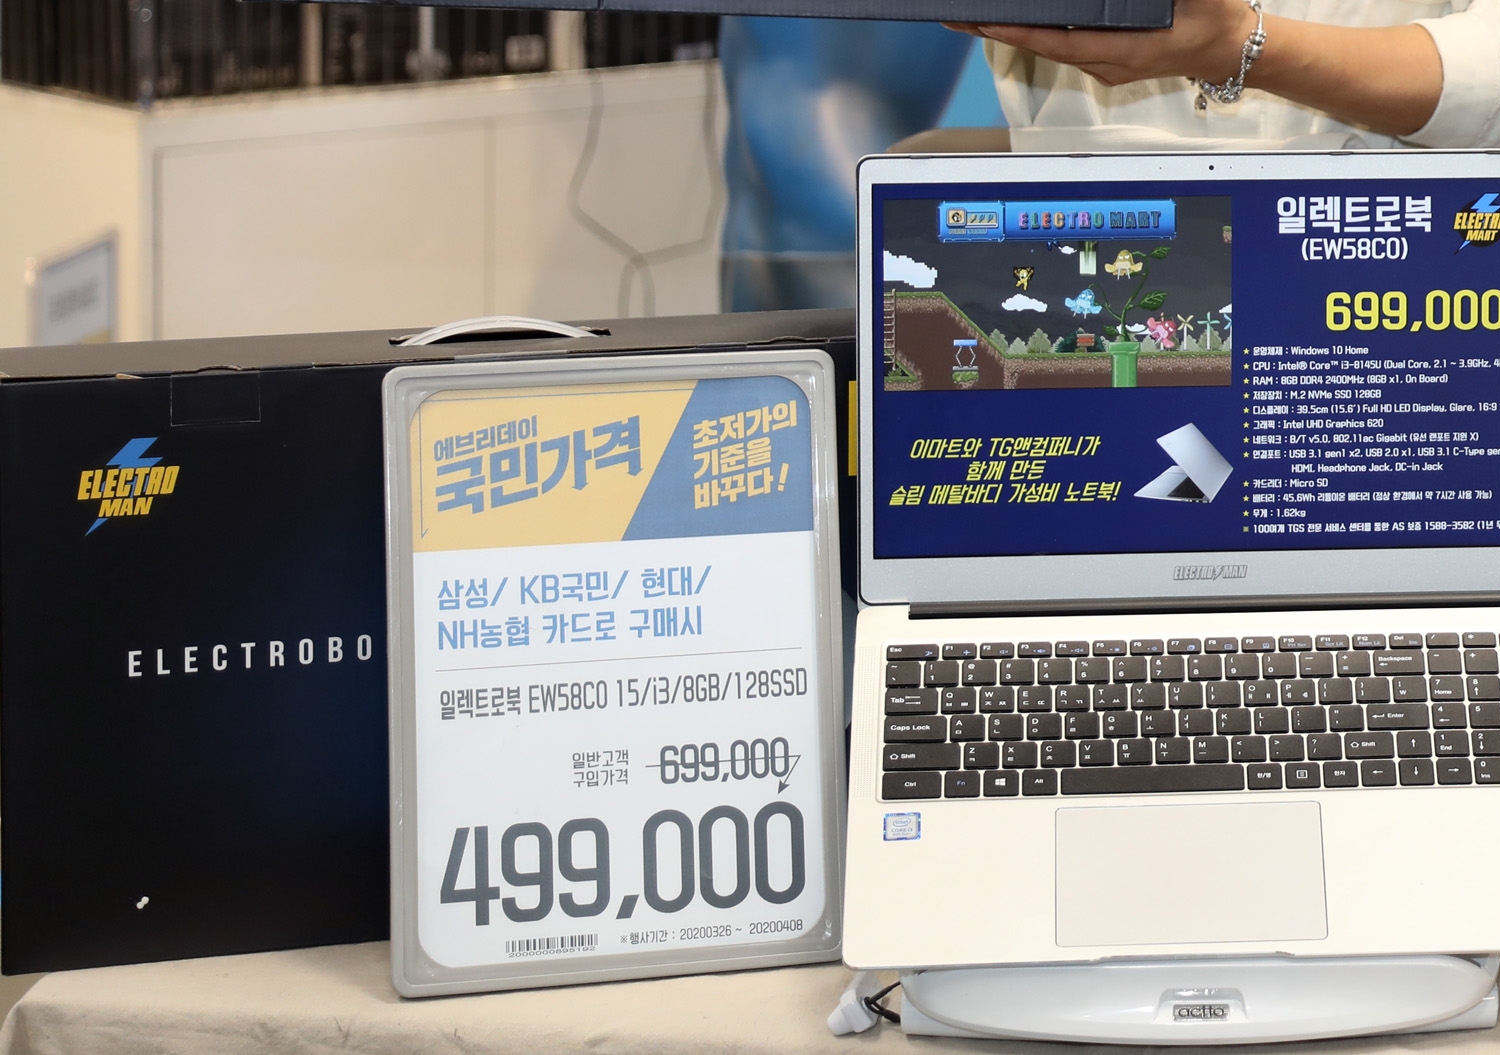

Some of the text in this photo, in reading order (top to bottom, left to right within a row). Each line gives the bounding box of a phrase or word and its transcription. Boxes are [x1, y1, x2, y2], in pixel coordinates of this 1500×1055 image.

[1019, 211, 1162, 229] ELECTRO MART
[1277, 195, 1433, 234] 일렉트로북
[1466, 229, 1498, 242] MART
[1253, 346, 1369, 356] 운영체제 Windows 10 Home
[1253, 362, 1270, 370] CPU
[1341, 360, 1382, 369] i3-8145U
[1383, 360, 1406, 369] (Dual
[1433, 359, 1447, 368] 2.1
[1253, 376, 1273, 385] RAM
[1281, 376, 1298, 384] 8GB
[1300, 376, 1323, 384] DDR4
[1325, 375, 1365, 384] 2400MHz
[1366, 375, 1387, 383] (8GB
[1405, 374, 1417, 383] On
[1419, 374, 1449, 383] Board)
[1253, 389, 1382, 400] 저장장치 M.2 NVMe SSD 128GB
[1253, 405, 1289, 414] 디스플레이
[1297, 405, 1329, 414] 39.5cm
[1363, 404, 1378, 413] Full
[1380, 404, 1392, 412] HD
[1394, 404, 1411, 412] LED
[1478, 403, 1497, 411] 16:9
[693, 399, 798, 447] 초저가의
[1253, 419, 1384, 429] 그래픽 Intel UHD Graphics 620
[434, 415, 538, 461] 에브리데이
[910, 435, 1101, 459] 이마트와 TG앤컴퍼니가
[1253, 435, 1282, 444] 네트워크
[1290, 435, 1306, 443] B/T
[1333, 434, 1374, 443] 802.11ac
[1376, 433, 1407, 442] Gigabit
[1409, 433, 1427, 442] (유선
[1452, 432, 1468, 441] 지원
[1469, 432, 1479, 441] X)
[435, 415, 644, 515] 국민가격
[693, 436, 772, 480] 기준을
[1317, 464, 1367, 472] Headphone
[1395, 462, 1420, 471] DC-in
[1421, 462, 1443, 470] Jack
[966, 459, 1046, 481] 함께 만든
[77, 465, 180, 501] ELECTRO
[694, 463, 789, 510] 바꾸다!
[1253, 478, 1329, 488] 카드리더 Micro SD
[889, 481, 1122, 507] 슬림 메탈바디 가성비 노트북!
[98, 497, 153, 518] MAN
[1253, 508, 1306, 517] 무게 1.62kg
[1288, 524, 1305, 532] TGS
[1307, 523, 1322, 532] 전문
[1325, 523, 1347, 532] 서비스
[1391, 522, 1405, 530] AS
[1407, 522, 1422, 530] 보증
[1425, 521, 1475, 530] 1588-3582
[1477, 521, 1494, 529] (1년
[1173, 565, 1248, 580] ELECTRO MAN
[437, 565, 713, 611] 삼성/ KB국민/ 현대/
[438, 605, 704, 650] NH농협 카드로 구매시
[128, 634, 373, 678] ELECTROBO
[439, 687, 522, 721] 일렉트로북
[616, 667, 808, 709] 15/i3/8GB/128SSD
[572, 749, 629, 769] 일반고객
[659, 736, 790, 785] 699,000
[572, 769, 629, 788] 구입가격
[439, 800, 806, 927] 499,000
[680, 926, 732, 941] 20200326
[749, 918, 804, 936] 20200408
[508, 946, 597, 958] 2000000895192
[1178, 1005, 1225, 1018] actto
